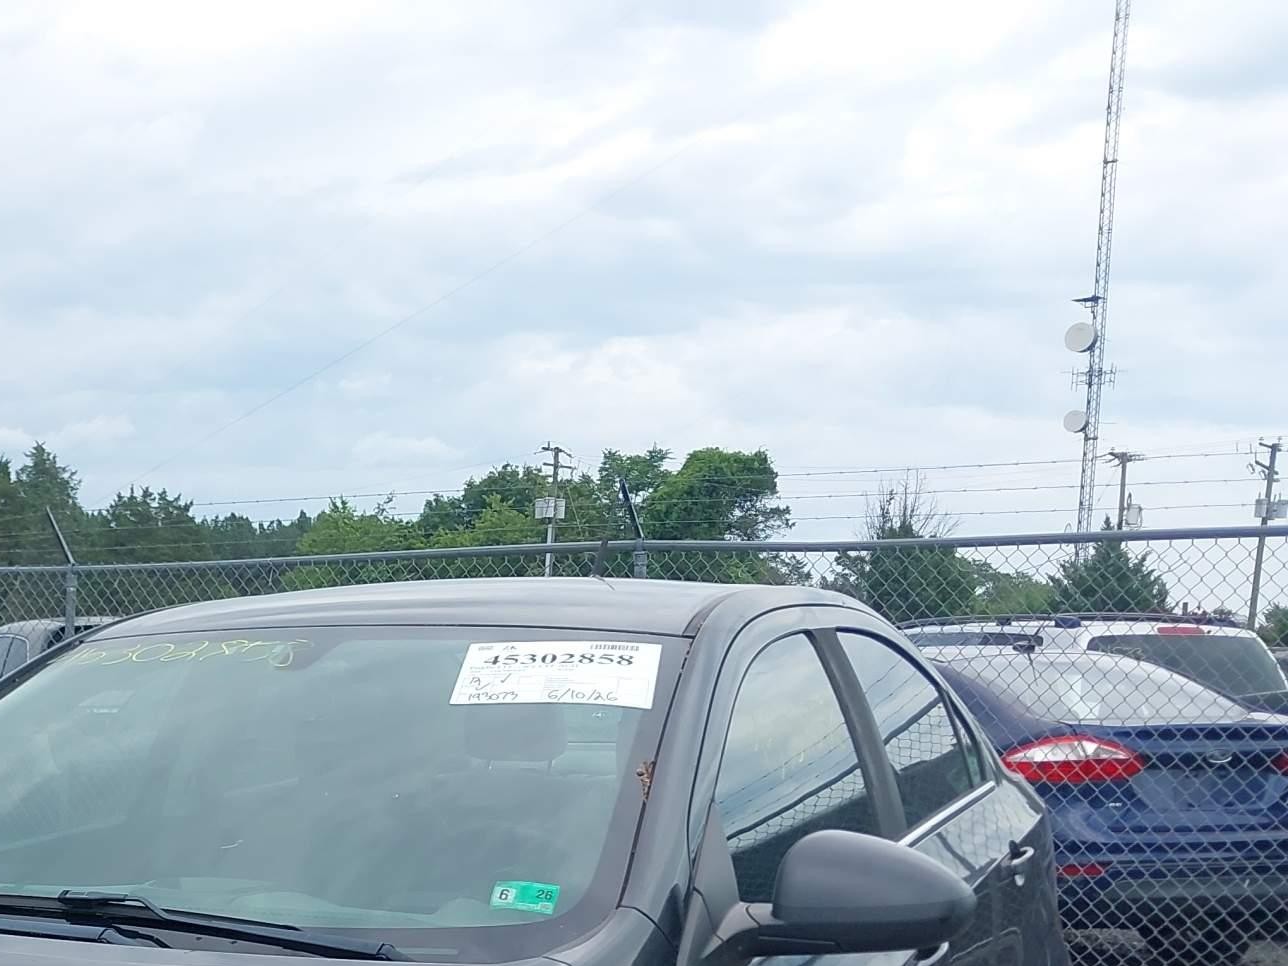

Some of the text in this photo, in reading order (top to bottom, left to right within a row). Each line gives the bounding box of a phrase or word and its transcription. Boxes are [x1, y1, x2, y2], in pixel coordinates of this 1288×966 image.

[483, 652, 634, 666] 45302858
[498, 888, 553, 901] 6 26
